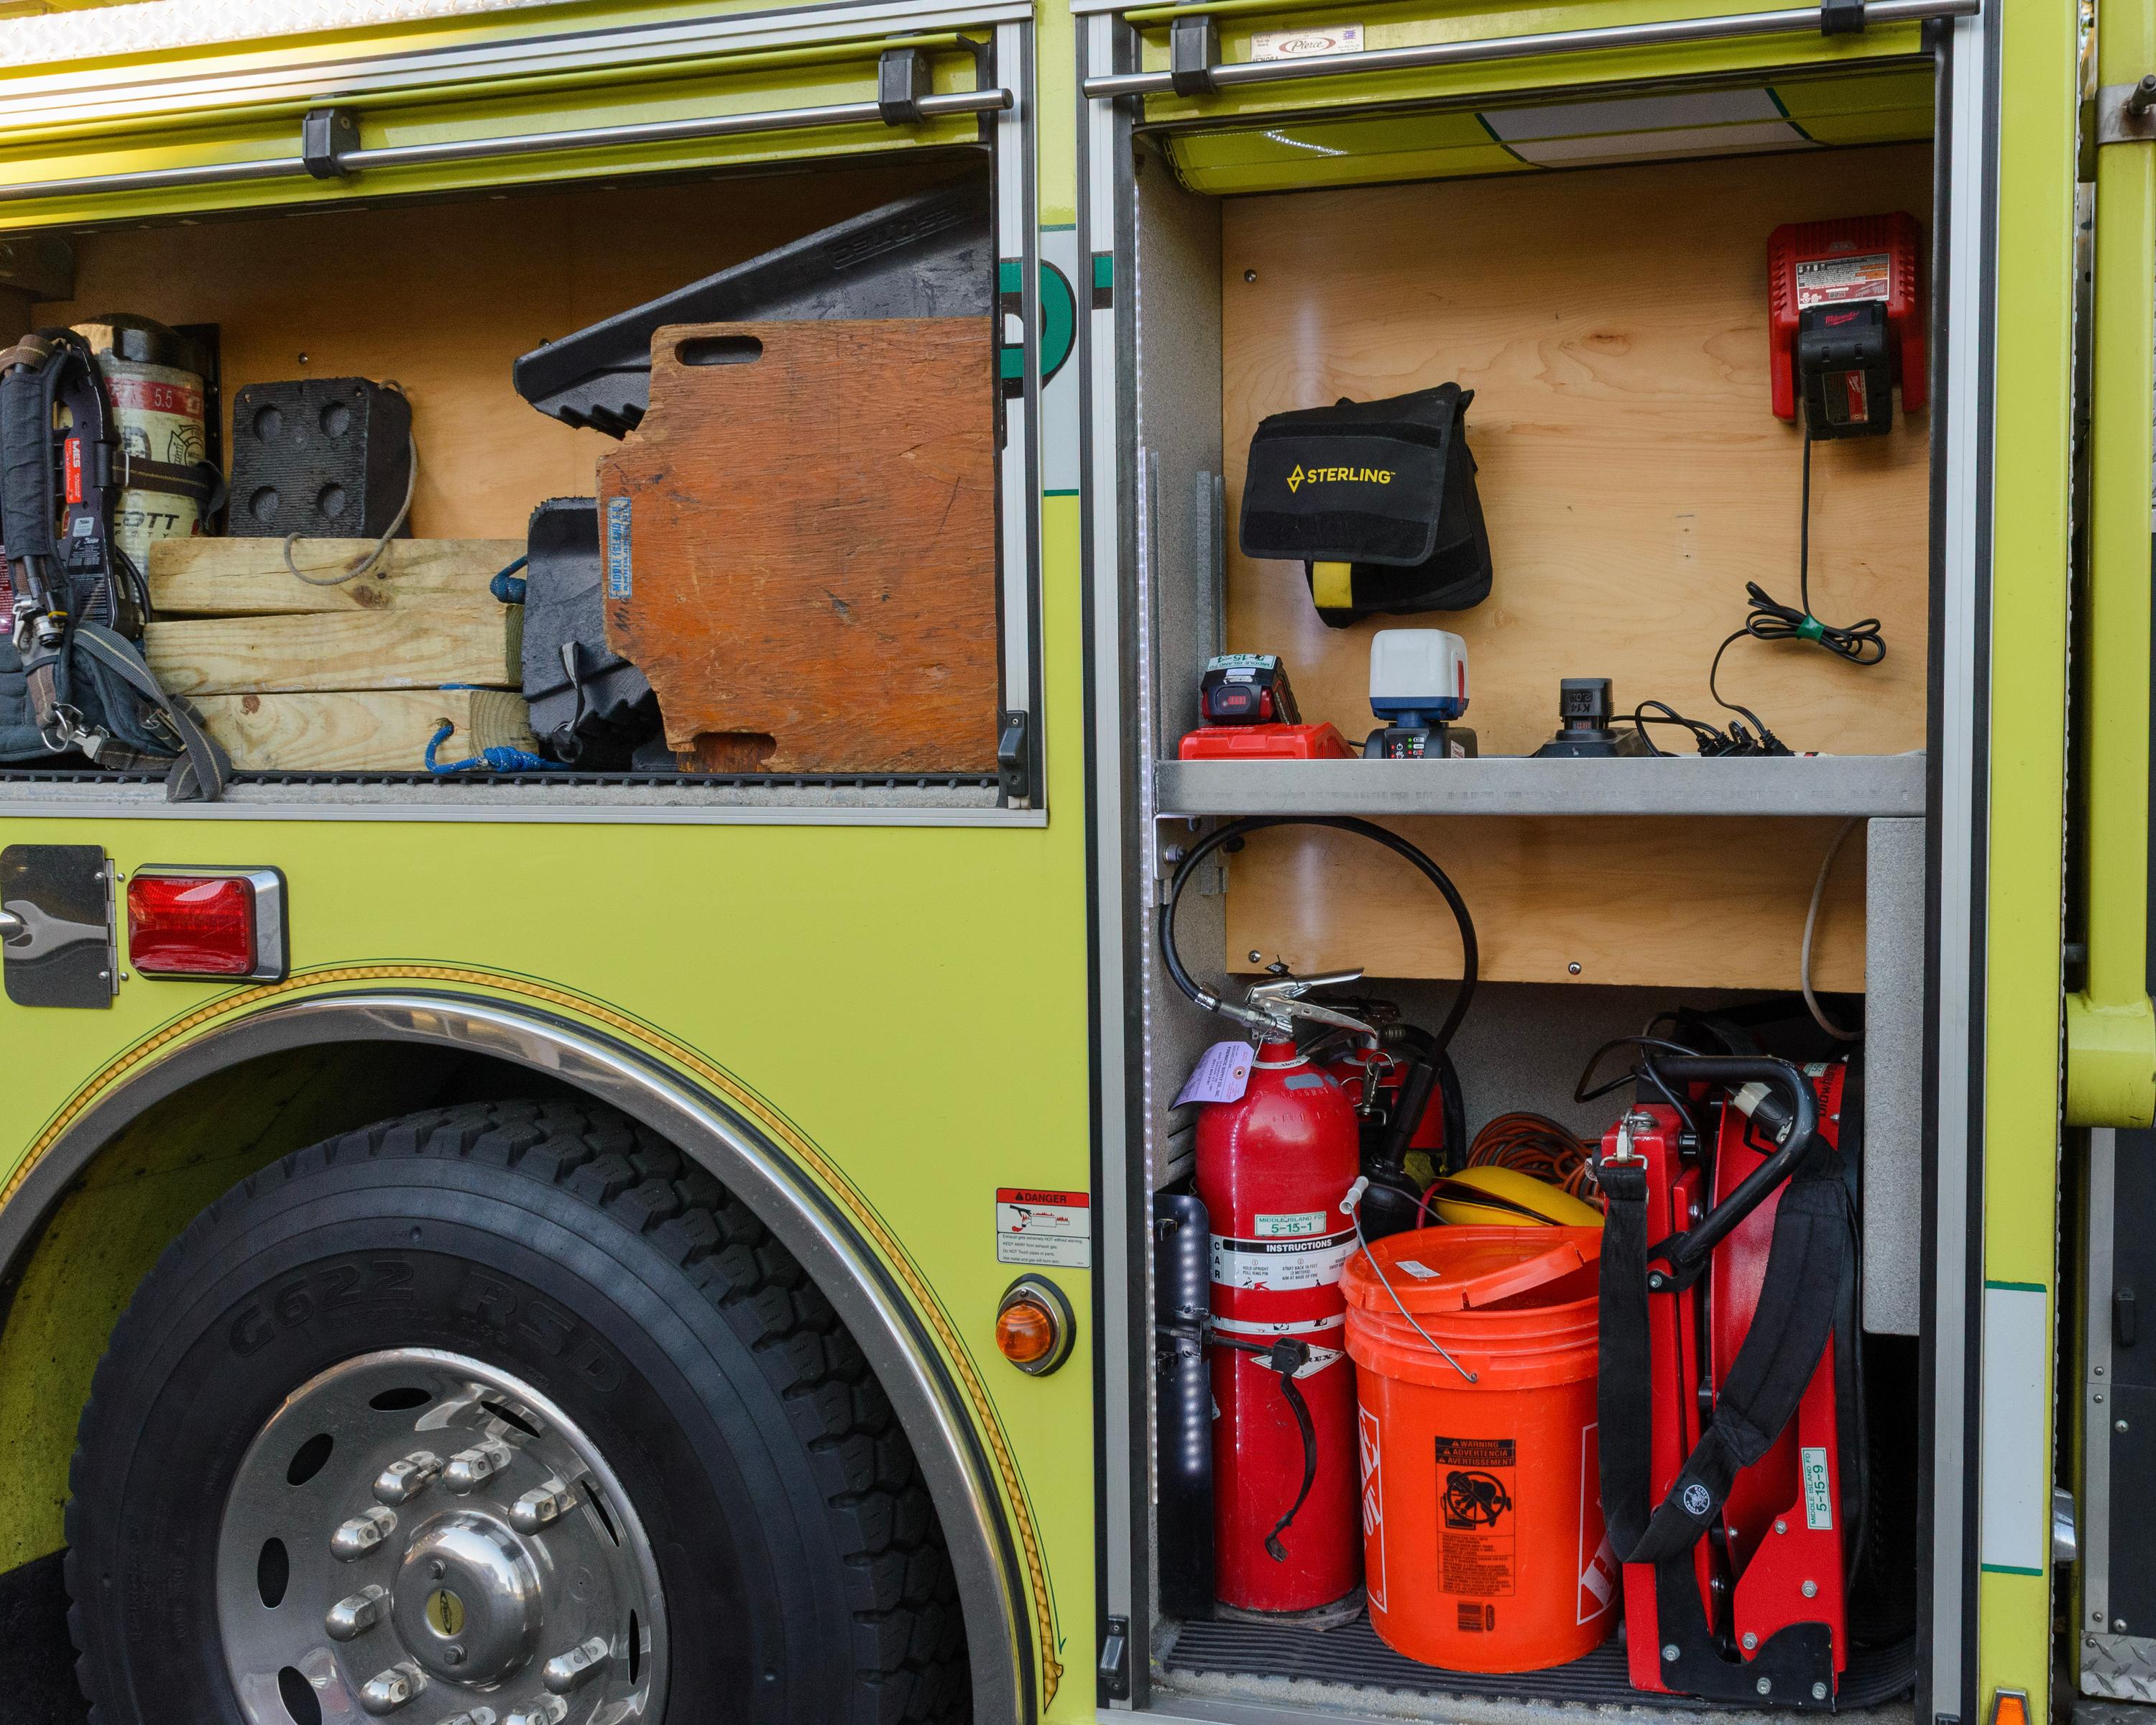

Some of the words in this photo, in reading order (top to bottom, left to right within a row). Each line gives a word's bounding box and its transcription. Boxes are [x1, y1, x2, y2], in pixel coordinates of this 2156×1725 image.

[1291, 39, 1322, 52] Pierce
[155, 389, 172, 408] 5.5
[115, 510, 180, 530] COTT
[1025, 1194, 1067, 1203] DANGER
[1271, 1223, 1312, 1233] 5-15-1
[1266, 1239, 1332, 1252] INSTRUCTIONS
[229, 1259, 414, 1358] G622
[457, 1267, 622, 1393] RSD
[1452, 1448, 1508, 1457] ADVERTENCIA
[1805, 1453, 1810, 1463] FD
[1448, 1457, 1514, 1466] AVERTISSEMENT
[1812, 1465, 1827, 1512] 5-15-9
